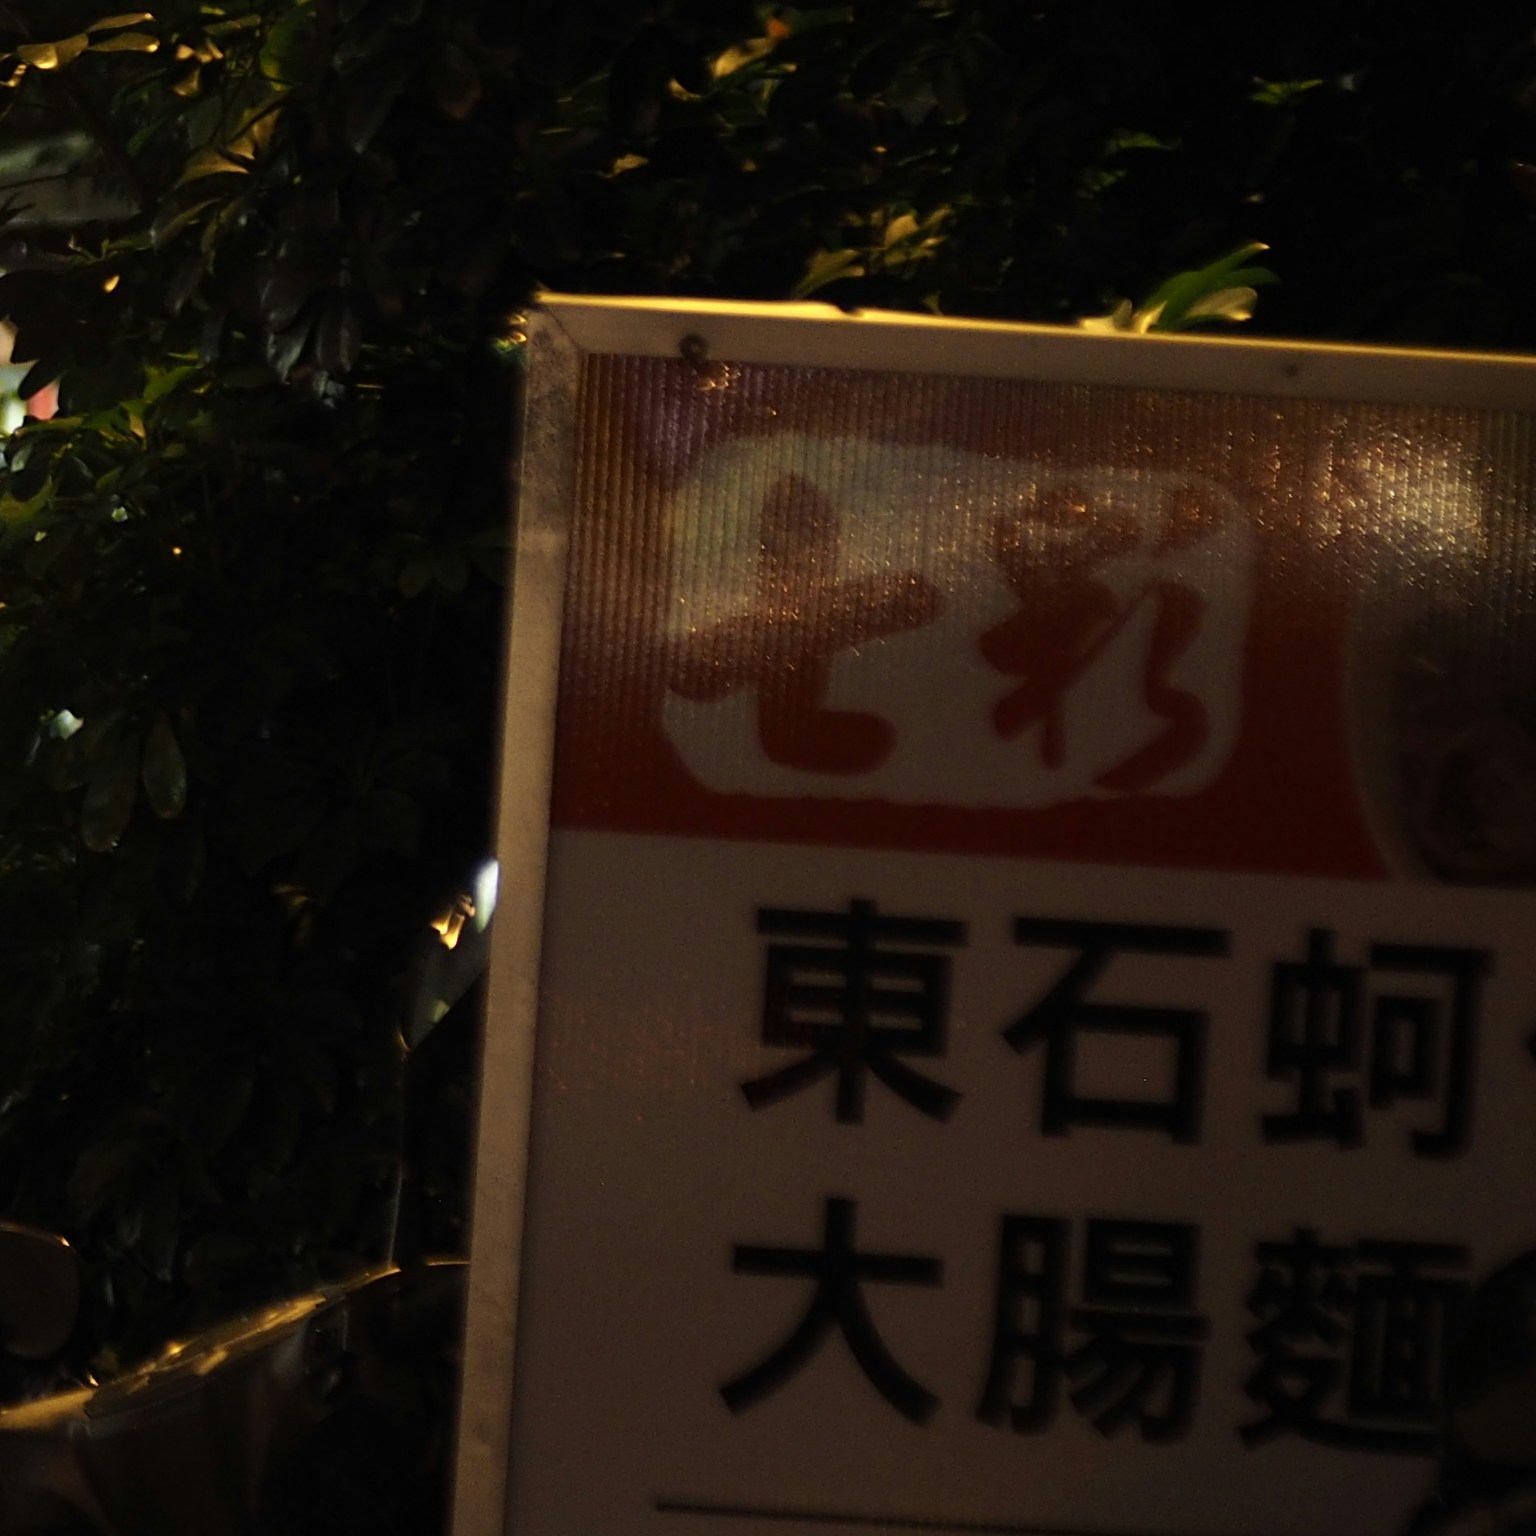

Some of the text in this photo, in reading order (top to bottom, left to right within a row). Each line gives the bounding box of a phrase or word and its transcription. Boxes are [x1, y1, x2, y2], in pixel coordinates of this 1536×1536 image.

[669, 467, 1234, 792] 七彩
[739, 899, 1536, 1164] 東石蚵
[718, 1195, 1470, 1458] 大腸麵
